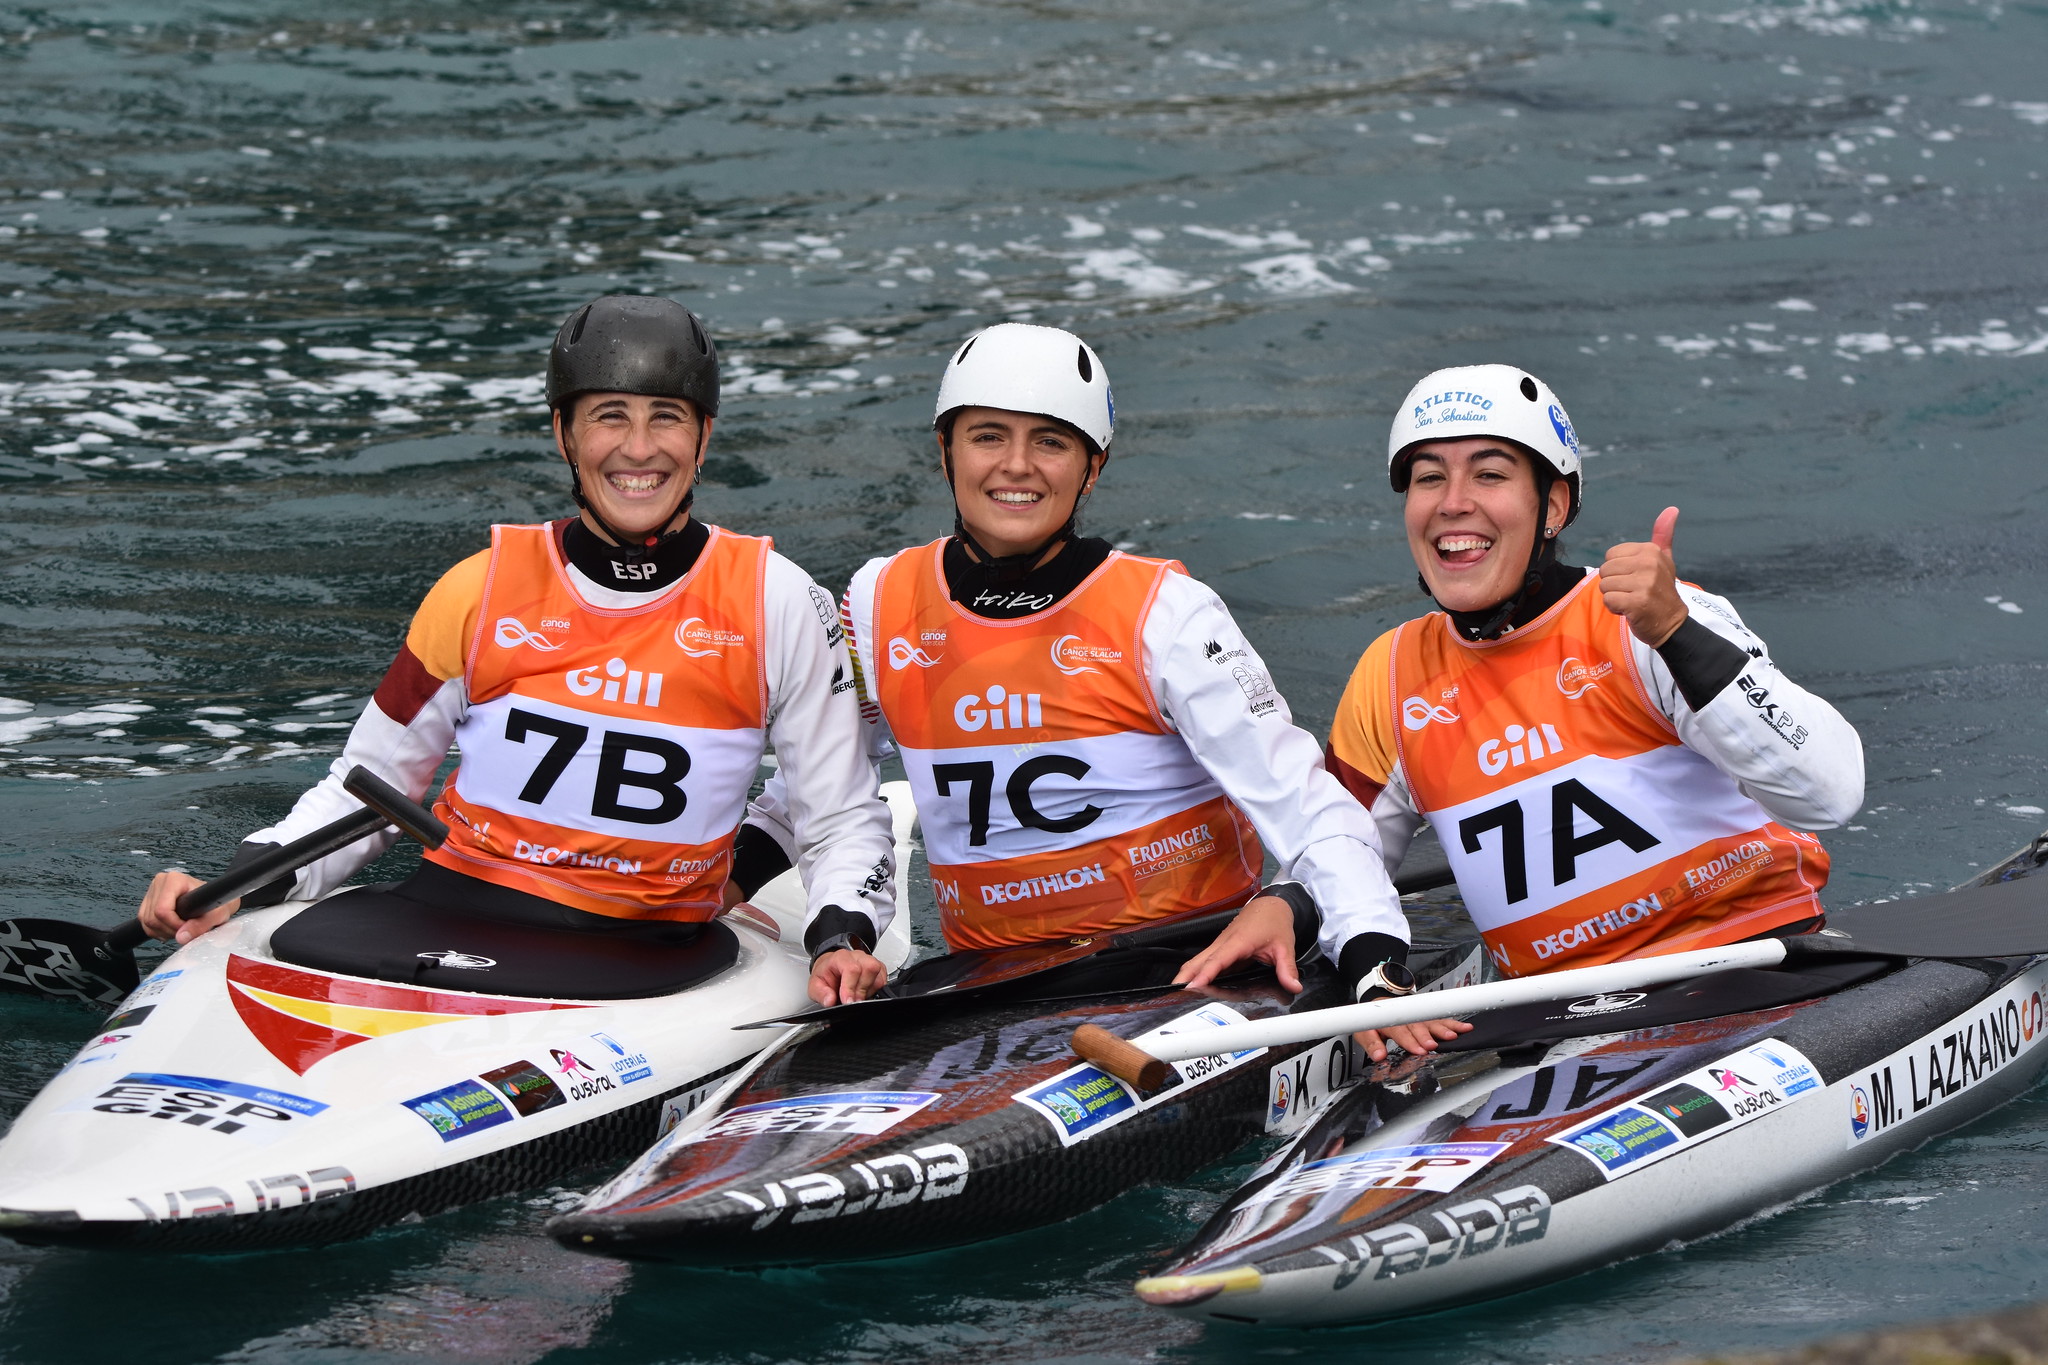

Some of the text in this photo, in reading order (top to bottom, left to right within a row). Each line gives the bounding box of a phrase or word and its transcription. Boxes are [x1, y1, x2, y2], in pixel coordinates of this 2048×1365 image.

[1414, 391, 1494, 418] ATLETICO
[1415, 408, 1488, 429] San Sebastian
[611, 560, 657, 580] ESP
[540, 620, 570, 629] canoe
[686, 631, 712, 640] CANOE
[714, 634, 745, 642] SLALOM
[920, 632, 947, 641] canoe
[1062, 648, 1088, 657] CANOE
[1090, 650, 1122, 659] SLALOM
[1563, 668, 1588, 681] CANOE
[1590, 661, 1613, 676] SLALOM
[565, 657, 664, 708] Gill
[954, 684, 1043, 732] Gill
[1477, 723, 1564, 776] Gill
[1758, 713, 1800, 751] paddlesports
[504, 707, 692, 825] 7B
[932, 754, 1105, 847] 7C
[513, 839, 642, 877] DECATHLON
[1127, 823, 1214, 867] ERDINGER
[1458, 777, 1662, 905] 7A
[1134, 842, 1216, 878] ALKOHOLFREI
[1684, 840, 1772, 889] ERDINGER
[1693, 854, 1775, 899] ALKOHOLFREI
[980, 862, 1105, 906] DECATHLON
[1531, 893, 1663, 960] DECATHLON
[1870, 1066, 1903, 1132] M.
[1908, 999, 2020, 1113] LAZKANO
[96, 1085, 293, 1121] ESP
[445, 1087, 496, 1113] Asturias
[570, 1074, 617, 1102] austral
[1068, 1074, 1116, 1102] Asturias
[1733, 1089, 1782, 1117] austral
[1602, 1112, 1657, 1140] Asturias
[1648, 1123, 1668, 1142] natural
